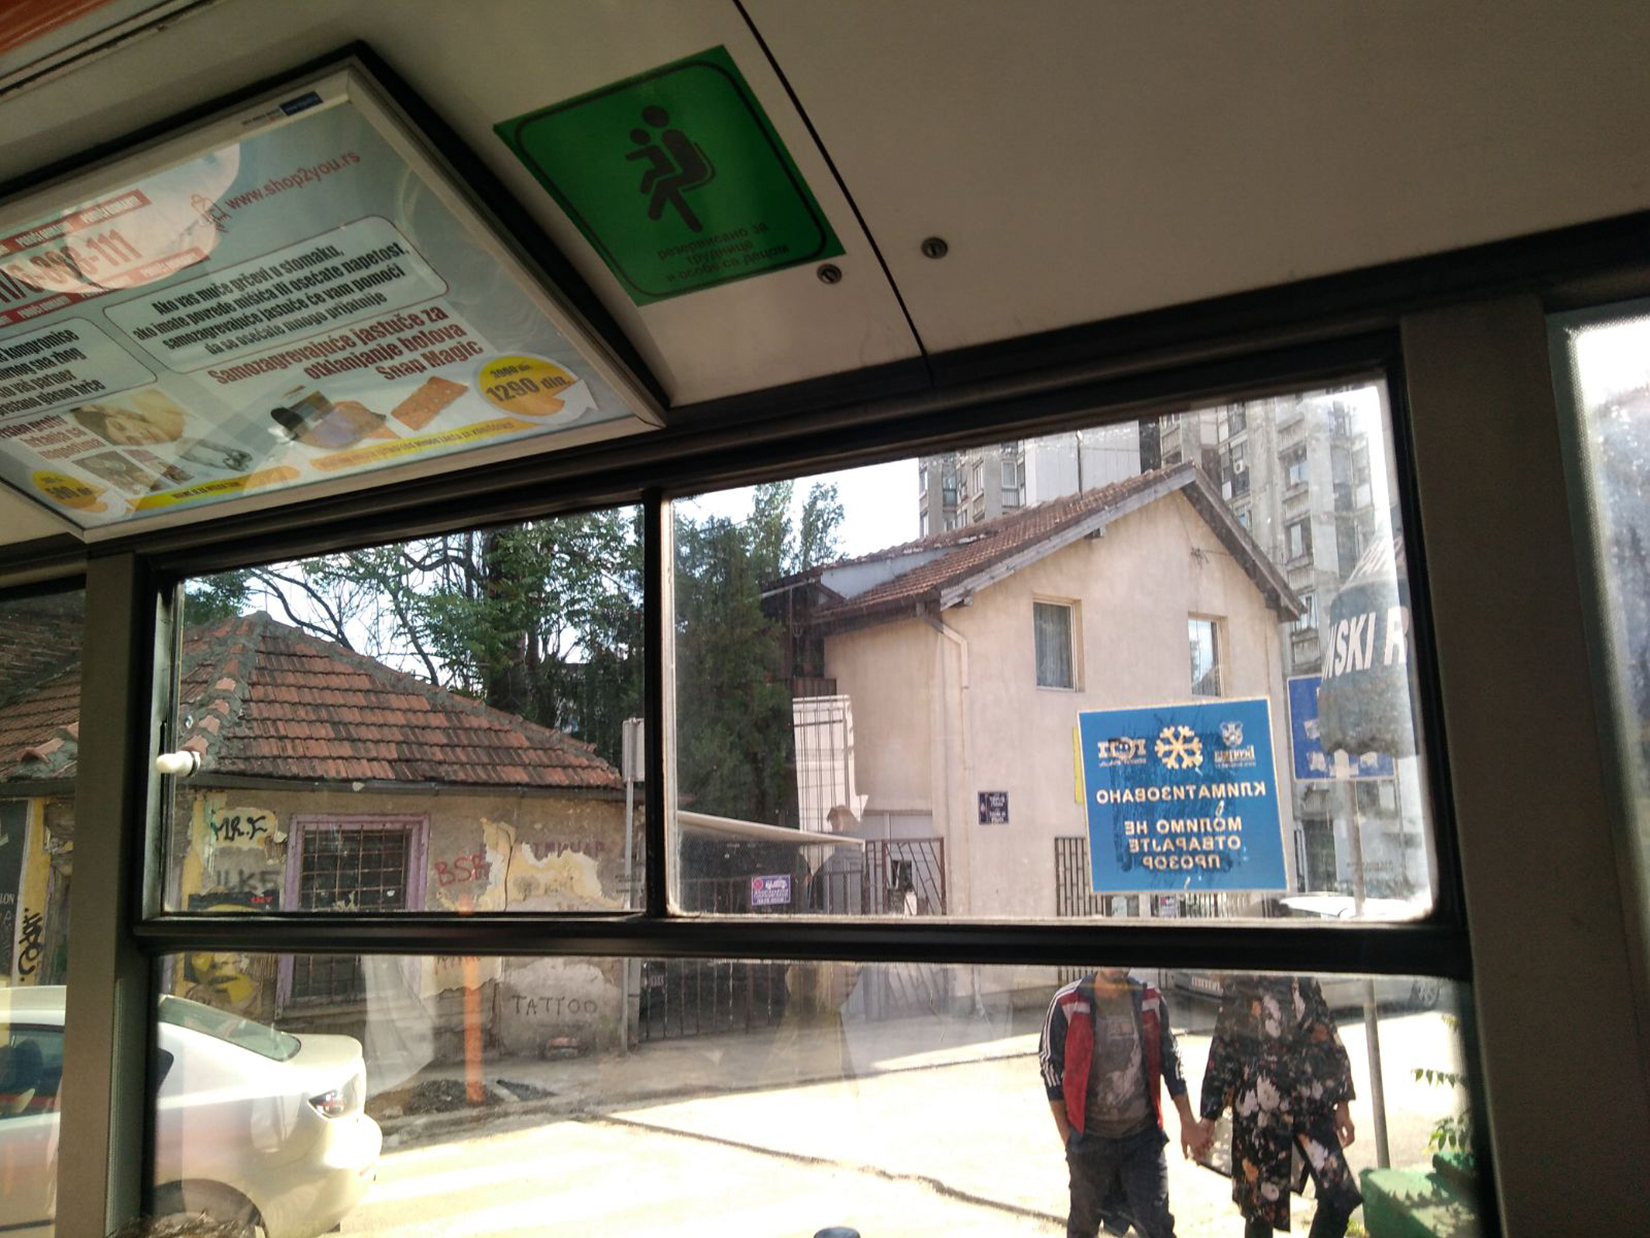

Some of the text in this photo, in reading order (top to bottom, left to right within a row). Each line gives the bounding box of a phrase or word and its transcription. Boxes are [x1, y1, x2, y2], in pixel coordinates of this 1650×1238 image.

[226, 151, 360, 210] www.shop2you.rs
[133, 323, 155, 340] ako
[155, 315, 190, 335] imate
[185, 301, 236, 326] povrede
[234, 288, 277, 310] mišića
[274, 282, 292, 297] ili
[289, 265, 344, 292] osećate
[152, 244, 345, 315] Ako vas muče grčevi u stomaku,
[163, 263, 406, 350] samozagrevajuće jastuče će vam pomoći
[204, 340, 225, 355] da
[220, 337, 239, 350] se
[282, 312, 328, 333] mnogo
[324, 292, 387, 319] prijatnije
[4, 329, 79, 360] kompromise
[29, 356, 58, 371] sna
[51, 347, 87, 365] zbog
[207, 305, 449, 385] Samozagrevajuće jastuče za
[303, 322, 467, 380] otklanjanje bolova
[375, 340, 484, 380] Snap Magic
[9, 379, 37, 393] vaš
[30, 369, 78, 391] partner
[36, 387, 80, 405] glasno
[70, 378, 106, 396] hrče
[486, 376, 572, 402] 1290 din.
[511, 994, 598, 1016] TATTOO
